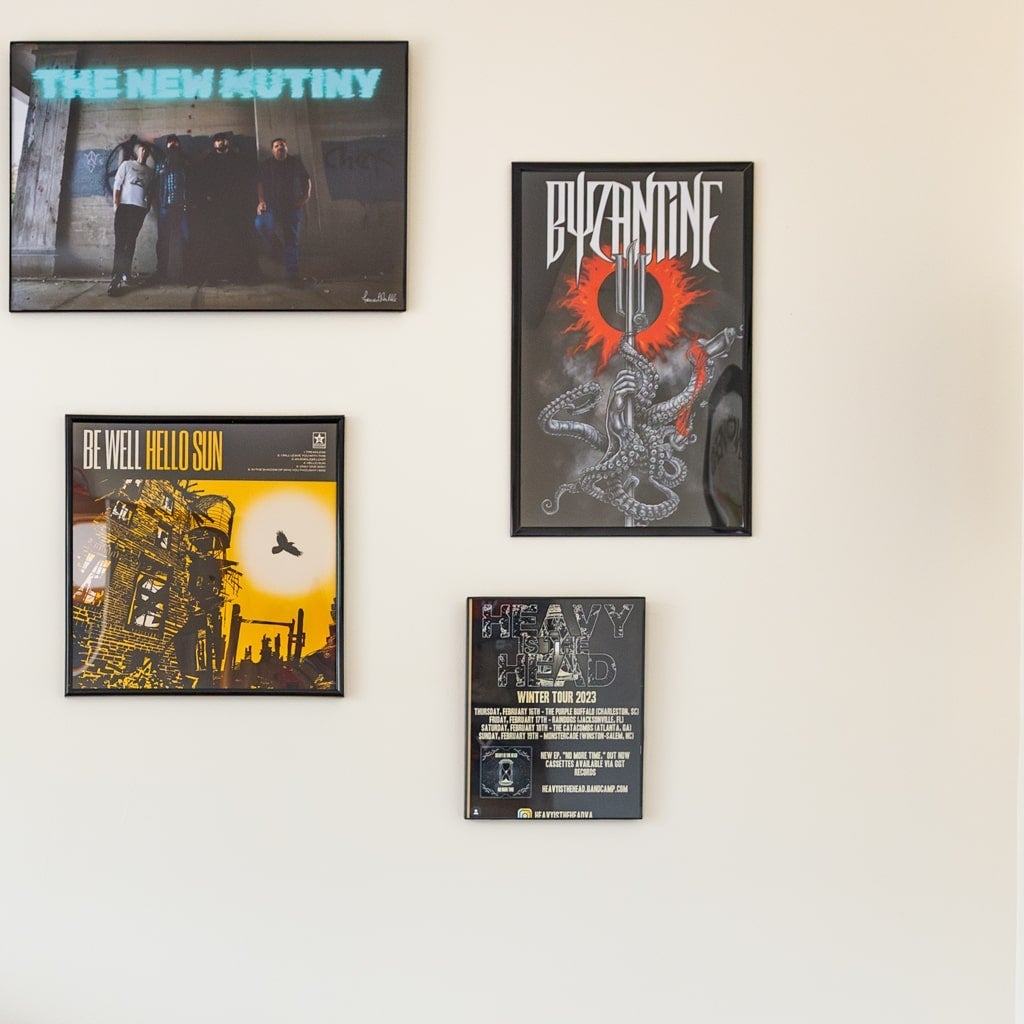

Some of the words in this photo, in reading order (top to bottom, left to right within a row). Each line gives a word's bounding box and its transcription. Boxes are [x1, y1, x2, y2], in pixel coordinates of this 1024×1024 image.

[33, 68, 118, 99] THE
[125, 68, 214, 99] NEW
[220, 68, 382, 99] MUTINY
[83, 430, 102, 470] BE
[105, 430, 142, 470] WELL
[145, 430, 189, 471] HELLO
[192, 430, 223, 471] SUN
[481, 603, 634, 638] HEAVY
[518, 637, 539, 654] IS
[497, 653, 617, 687] HEAD
[517, 690, 550, 703] WINTER
[552, 690, 574, 703] TOUR
[576, 690, 596, 703] 2023
[502, 707, 528, 716] FEBRUARY
[545, 707, 555, 716] THE
[555, 707, 573, 716] PURPLE
[509, 716, 534, 724] FEBRUARY
[510, 724, 535, 732] FEBRUARY
[553, 724, 562, 732] THE
[501, 732, 526, 740] FEBRUARY
[540, 751, 553, 760] NEW
[573, 751, 588, 760] MORE
[606, 751, 617, 760] OUT
[617, 751, 631, 760] NOW
[545, 760, 574, 768] CASSETTES
[575, 760, 603, 768] AVAILABLE
[604, 760, 614, 768] VIA
[574, 768, 596, 776] RECORDS
